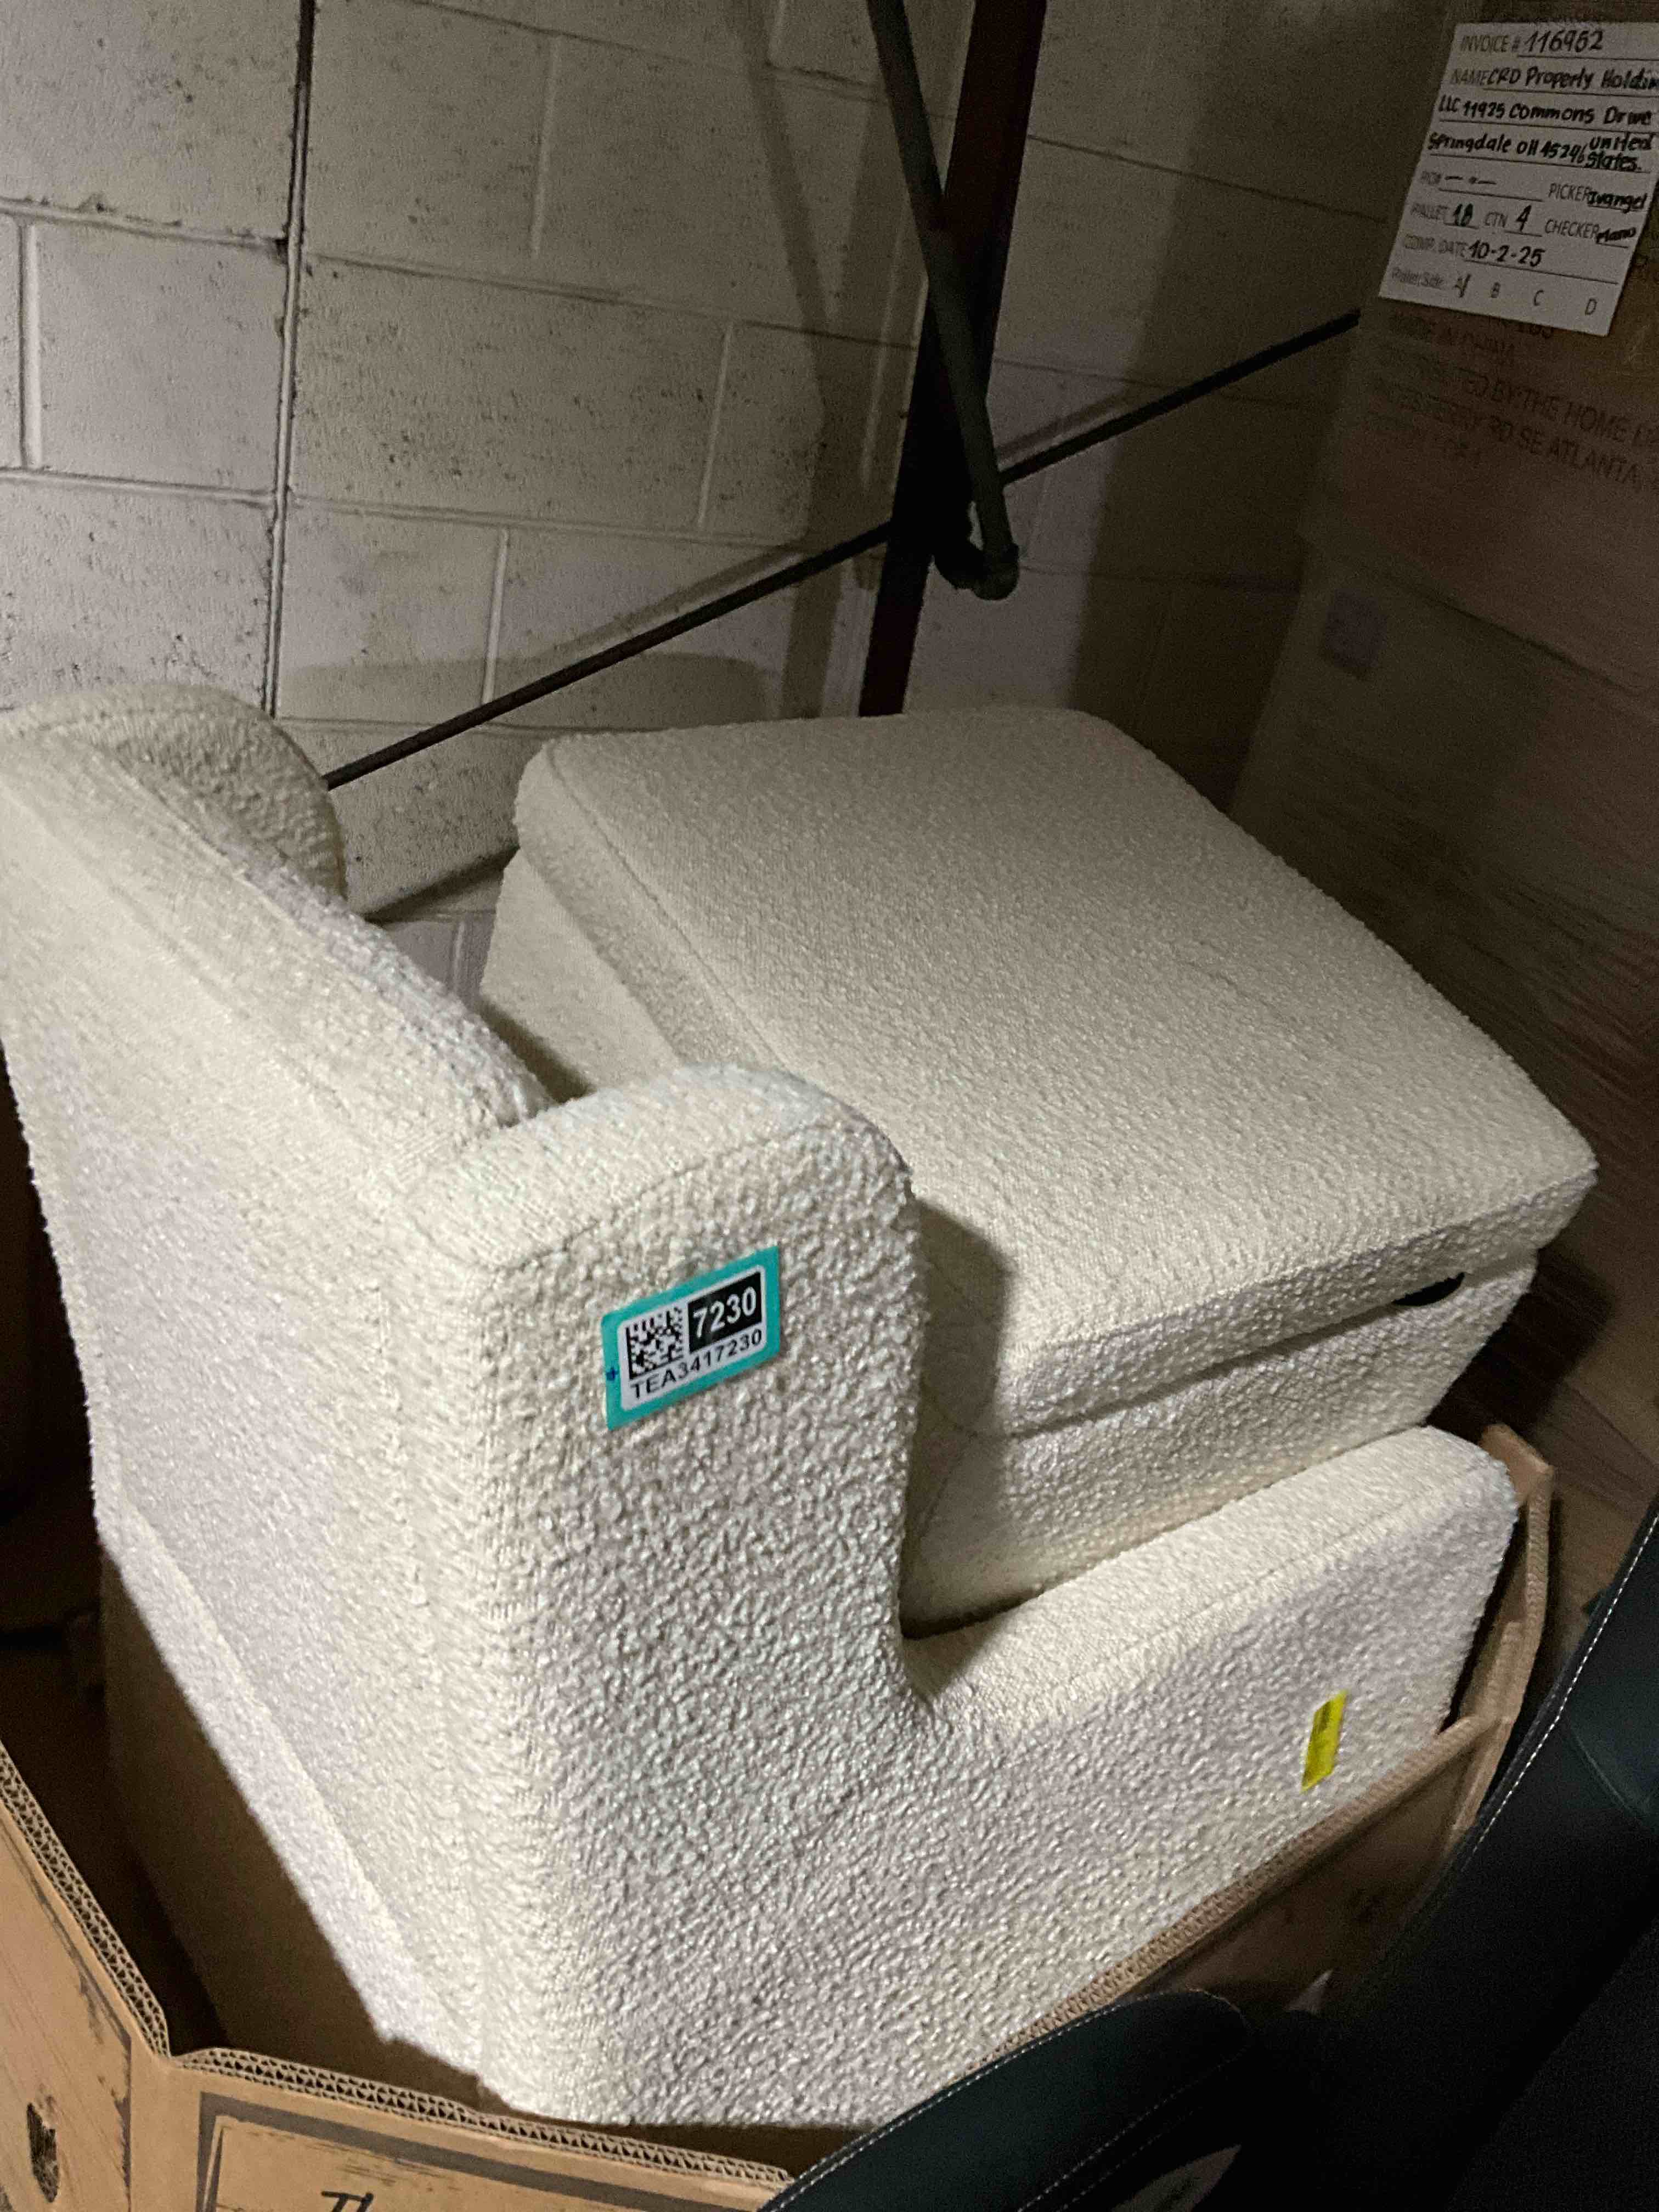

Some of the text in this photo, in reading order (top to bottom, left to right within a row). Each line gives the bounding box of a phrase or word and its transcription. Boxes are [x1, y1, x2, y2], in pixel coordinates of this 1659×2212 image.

[1459, 35, 1509, 53] INVOICE
[1544, 219, 1601, 239] CHECKER
[1564, 401, 1629, 442] HOME
[692, 1286, 757, 1338] 7230
[631, 1328, 762, 1399] TEA3417230
